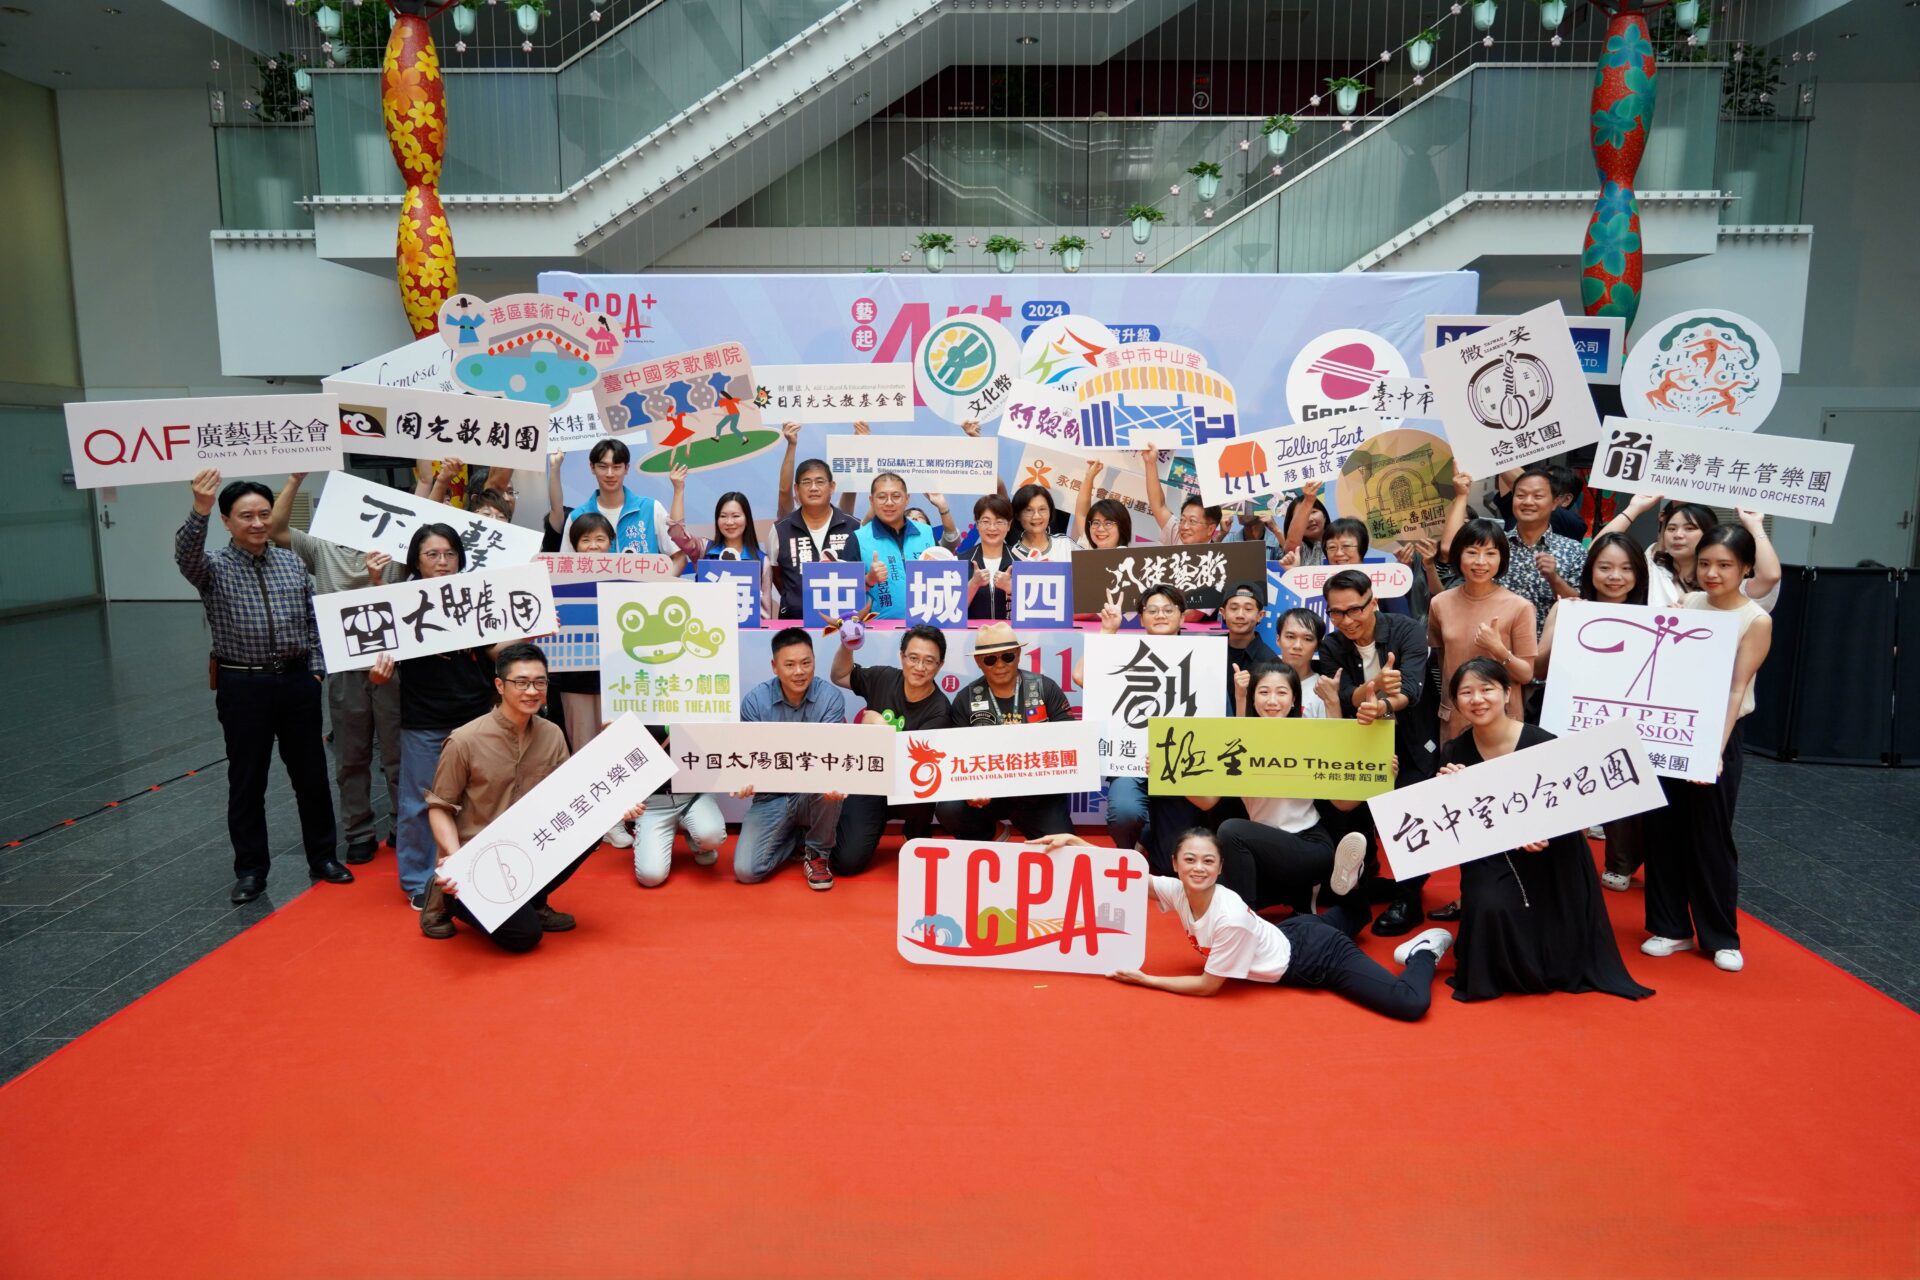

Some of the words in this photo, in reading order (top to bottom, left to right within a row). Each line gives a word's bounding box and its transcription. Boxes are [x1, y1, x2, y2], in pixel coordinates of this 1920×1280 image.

[489, 302, 587, 328] 港區藝術中心
[563, 291, 658, 338] PA+
[1028, 304, 1064, 317] 2024
[855, 330, 874, 348] 起
[602, 345, 744, 395] 臺中國家歌劇院
[1103, 347, 1202, 369] 臺中市中山堂
[777, 392, 908, 409] 日月光文教基金會
[967, 373, 1013, 418] 文化幣
[196, 418, 330, 449] 廣藝基金會
[396, 411, 541, 453] 國光歌劇團
[547, 414, 585, 435] 米特
[911, 468, 939, 476] Precision
[1652, 448, 1832, 493] 臺灣青年管樂團
[1651, 472, 1689, 489] TAIWAN
[1691, 479, 1726, 494] YOUTH
[1728, 484, 1758, 498] WIND
[1760, 489, 1827, 508] ORCHESTRA
[809, 571, 858, 619] 屯
[908, 569, 963, 624] 城
[1015, 574, 1067, 622] 四
[944, 676, 957, 691] 月
[612, 699, 648, 713] LITTLE
[651, 699, 680, 713] FROG
[685, 699, 733, 714] THEATRE
[1572, 700, 1698, 728] TAIPEI
[1570, 715, 1695, 742] PERSSION
[950, 748, 1079, 775] 九天民俗技藝團
[984, 772, 1003, 781] FOLK
[1003, 771, 1026, 780] DRUMS
[1033, 770, 1052, 779] ARTS
[1052, 768, 1079, 778] TROUPE
[1109, 762, 1125, 773] Eye
[1249, 756, 1298, 769] MAD
[1303, 757, 1387, 772] Theater
[532, 747, 650, 851] 共鳴室內樂團
